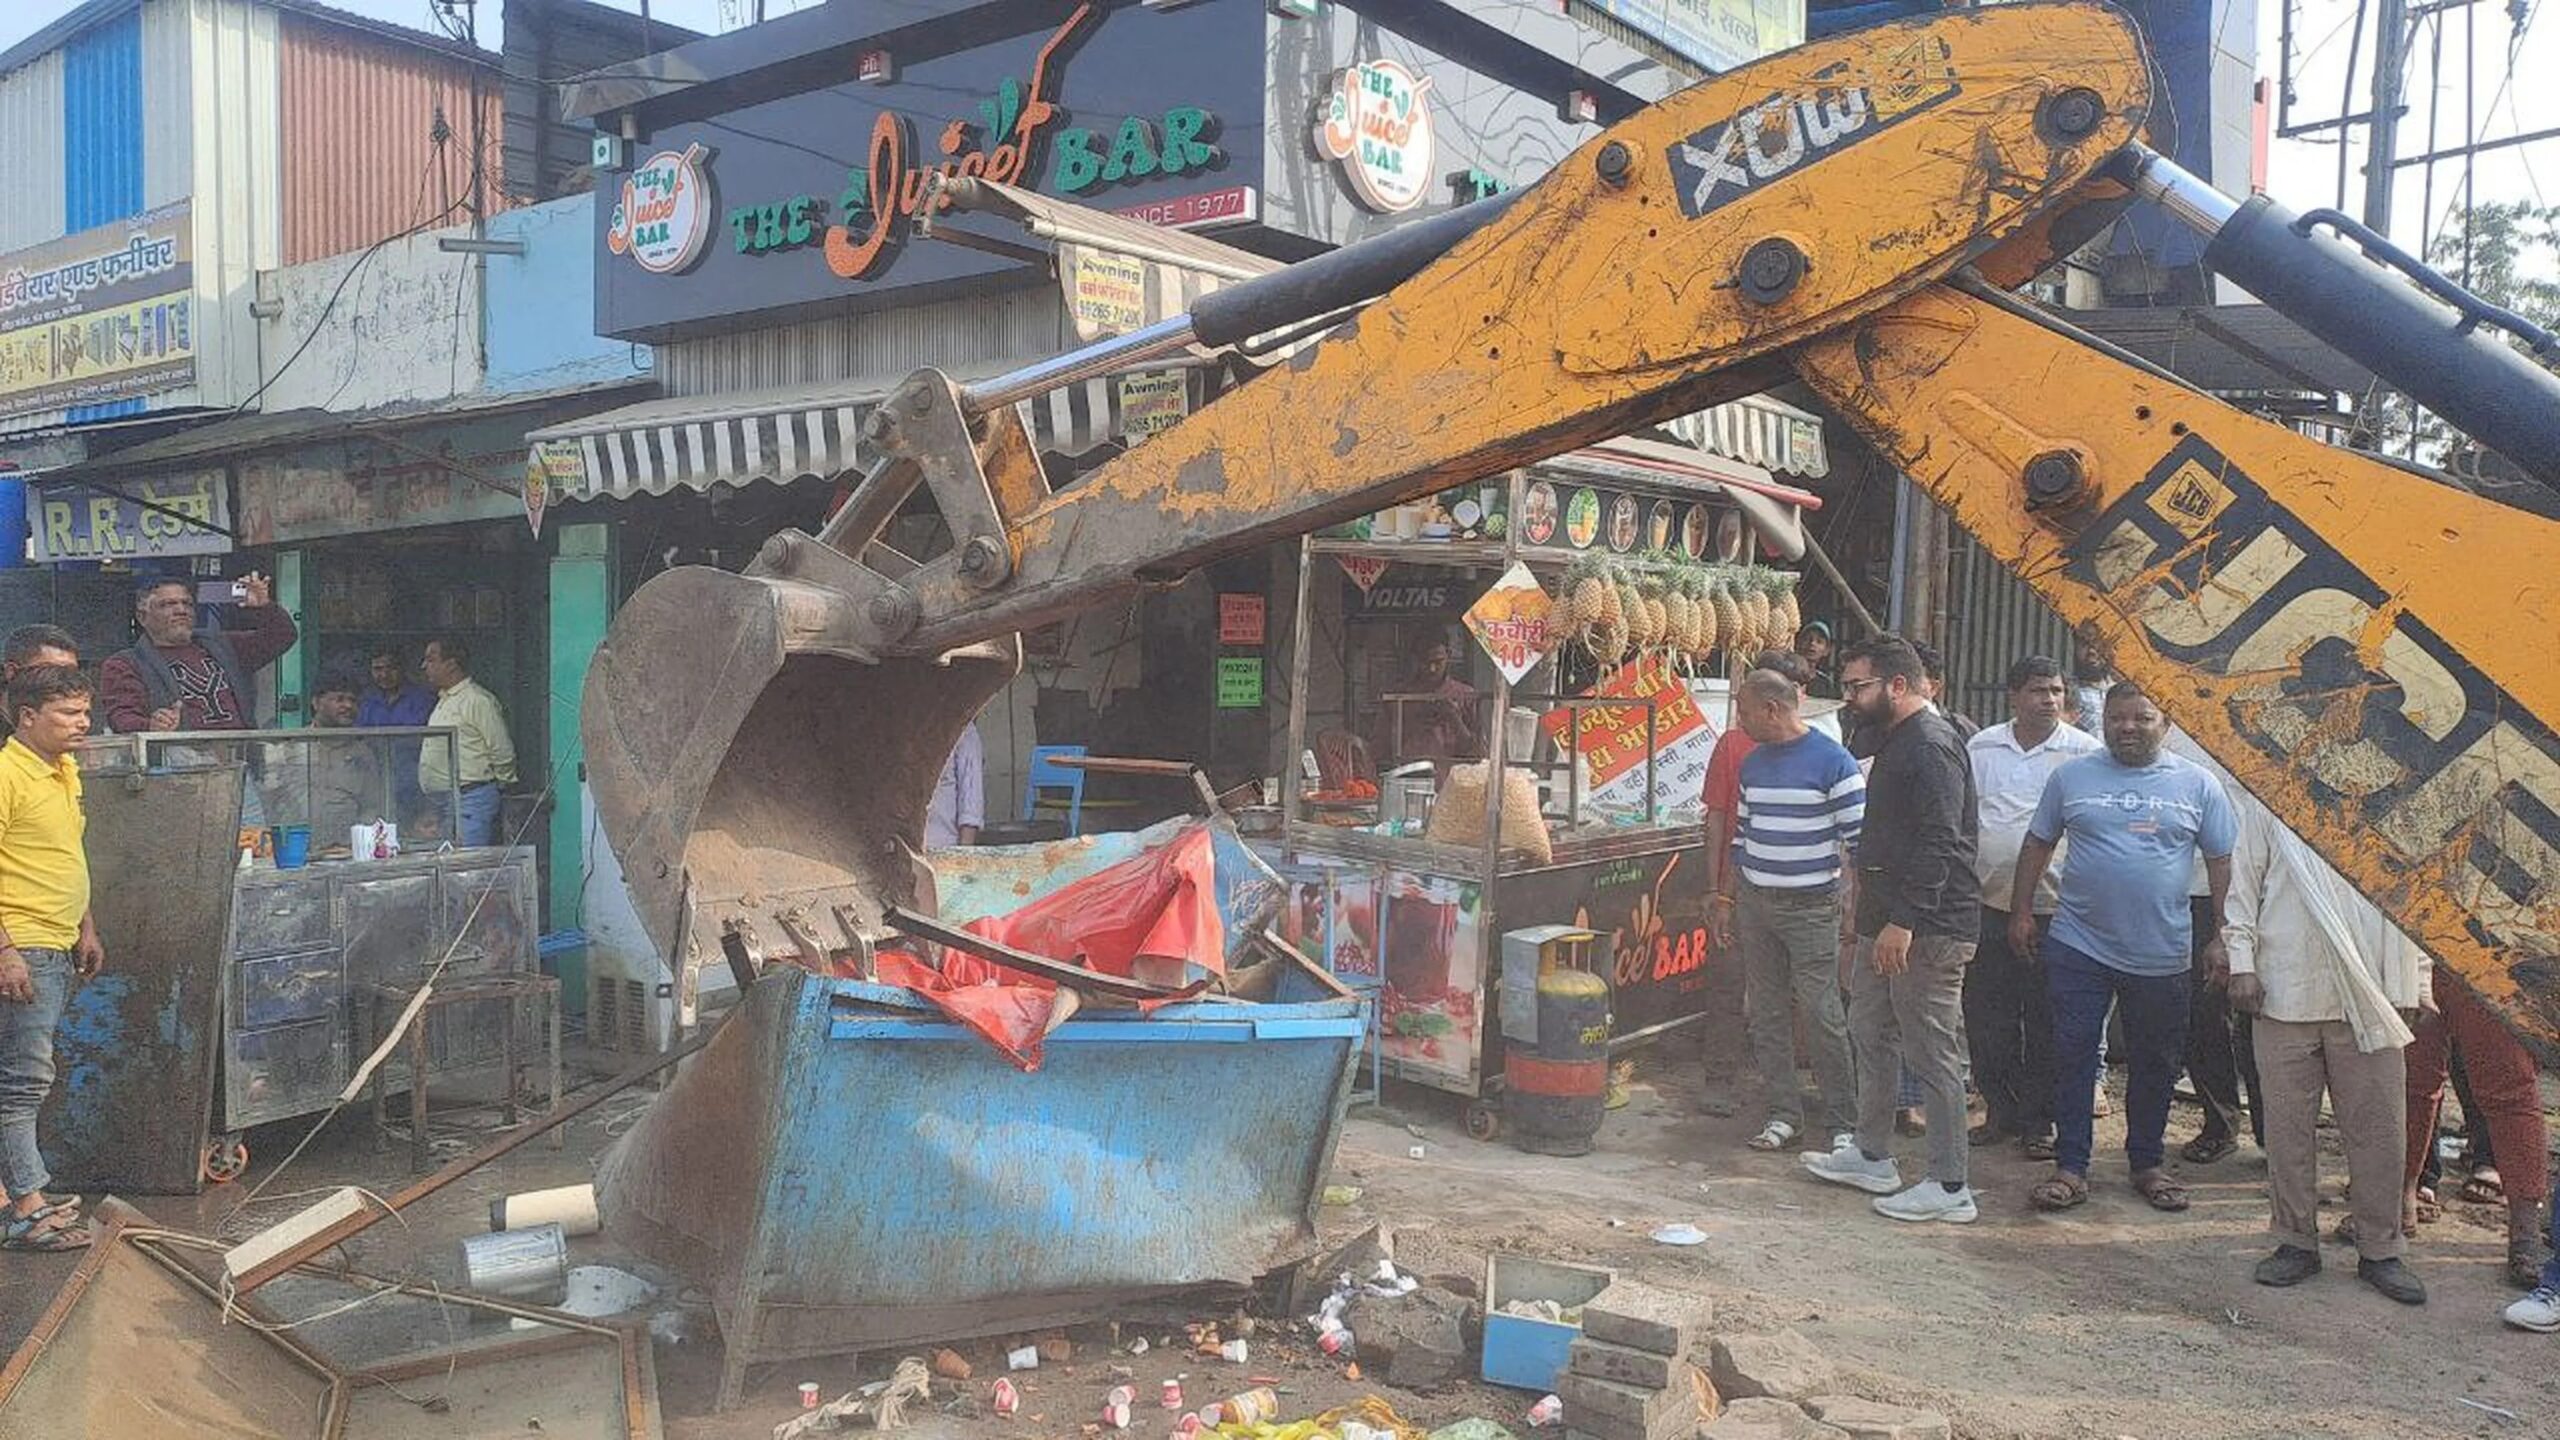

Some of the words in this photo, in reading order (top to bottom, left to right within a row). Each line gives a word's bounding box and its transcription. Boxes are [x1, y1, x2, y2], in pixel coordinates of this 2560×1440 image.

[1360, 65, 1393, 98] THE
[1362, 139, 1403, 174] BAR
[633, 166, 661, 190] THE
[731, 195, 812, 252] THE
[1055, 104, 1211, 192] BAR
[1117, 205, 1176, 224] NCE
[1186, 193, 1240, 218] 1977
[635, 221, 670, 248] BAR
[0, 267, 57, 305] र्डवेयर
[1082, 258, 1141, 285] Awning
[1124, 380, 1179, 395] Awning
[2171, 479, 2211, 517] JCB
[45, 497, 136, 554] R.R.
[1364, 587, 1447, 609] VOLTAS
[1487, 614, 1545, 643] कचौरी
[1653, 926, 1707, 981] BAR
